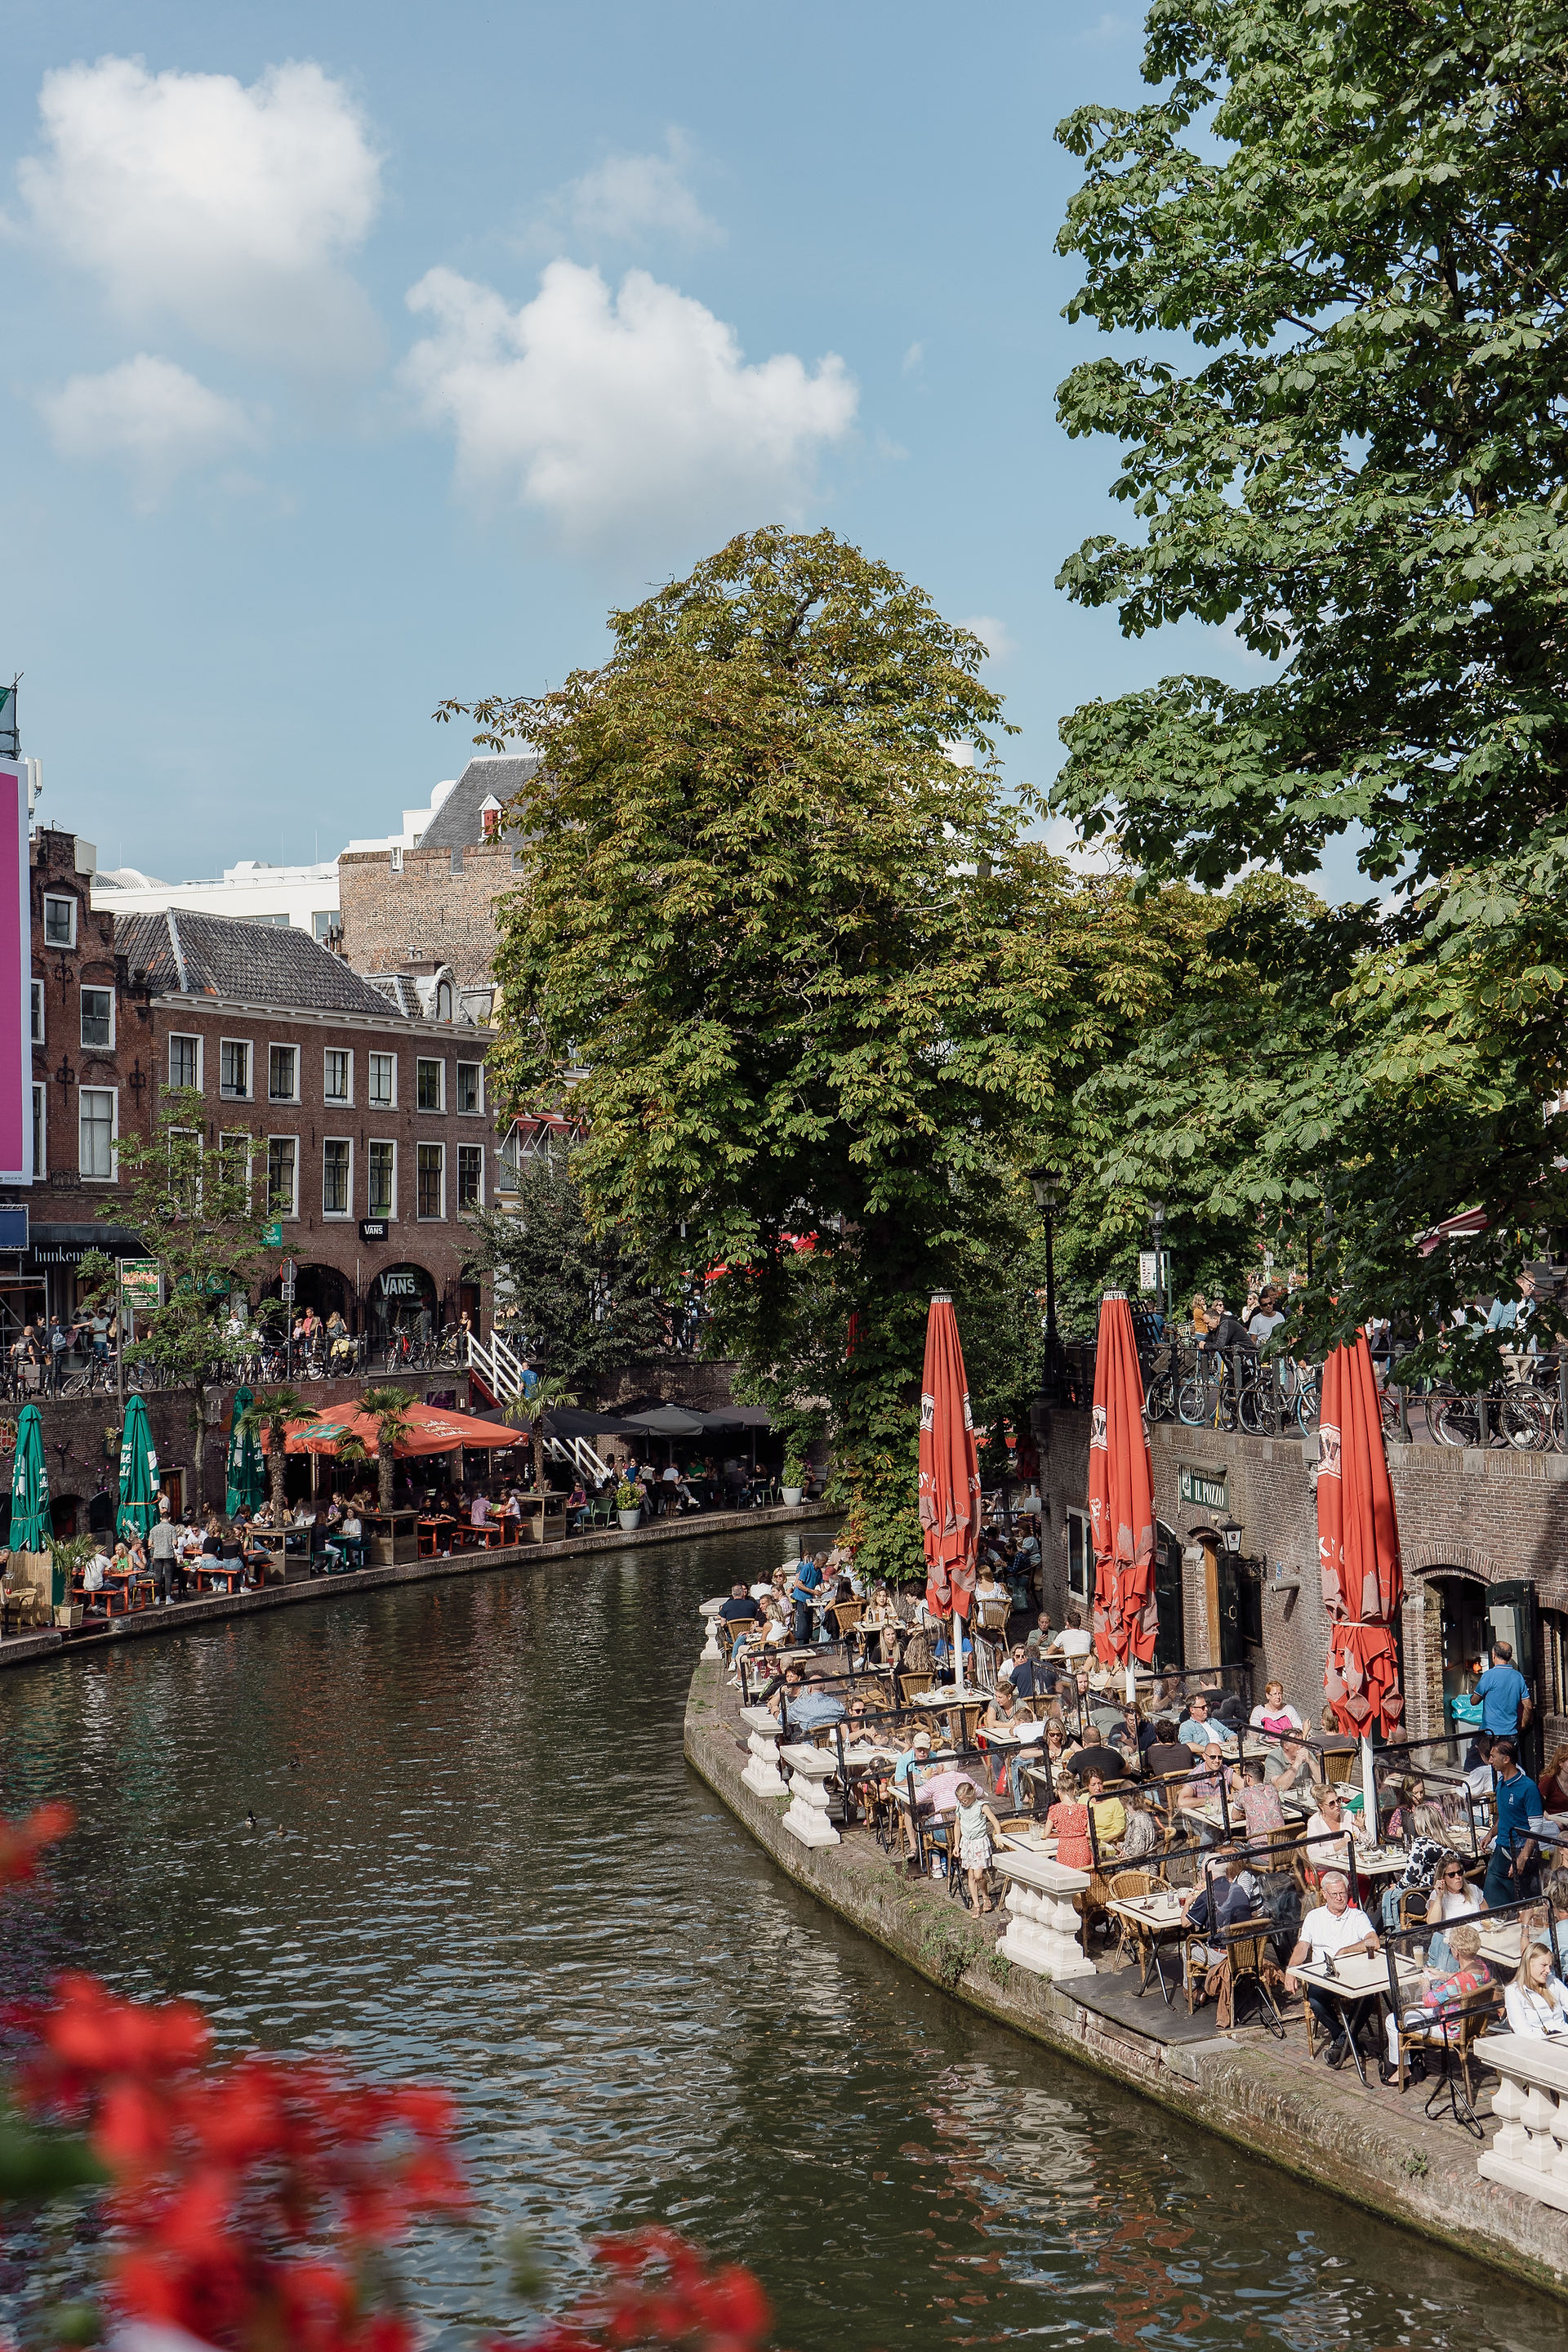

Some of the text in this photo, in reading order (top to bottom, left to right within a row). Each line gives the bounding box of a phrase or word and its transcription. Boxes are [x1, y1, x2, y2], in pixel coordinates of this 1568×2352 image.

[364, 1225, 384, 1235] VANS
[35, 1245, 111, 1263] hunkemr
[380, 1273, 416, 1295] VANS
[1195, 1480, 1224, 1508] IL POZZO
